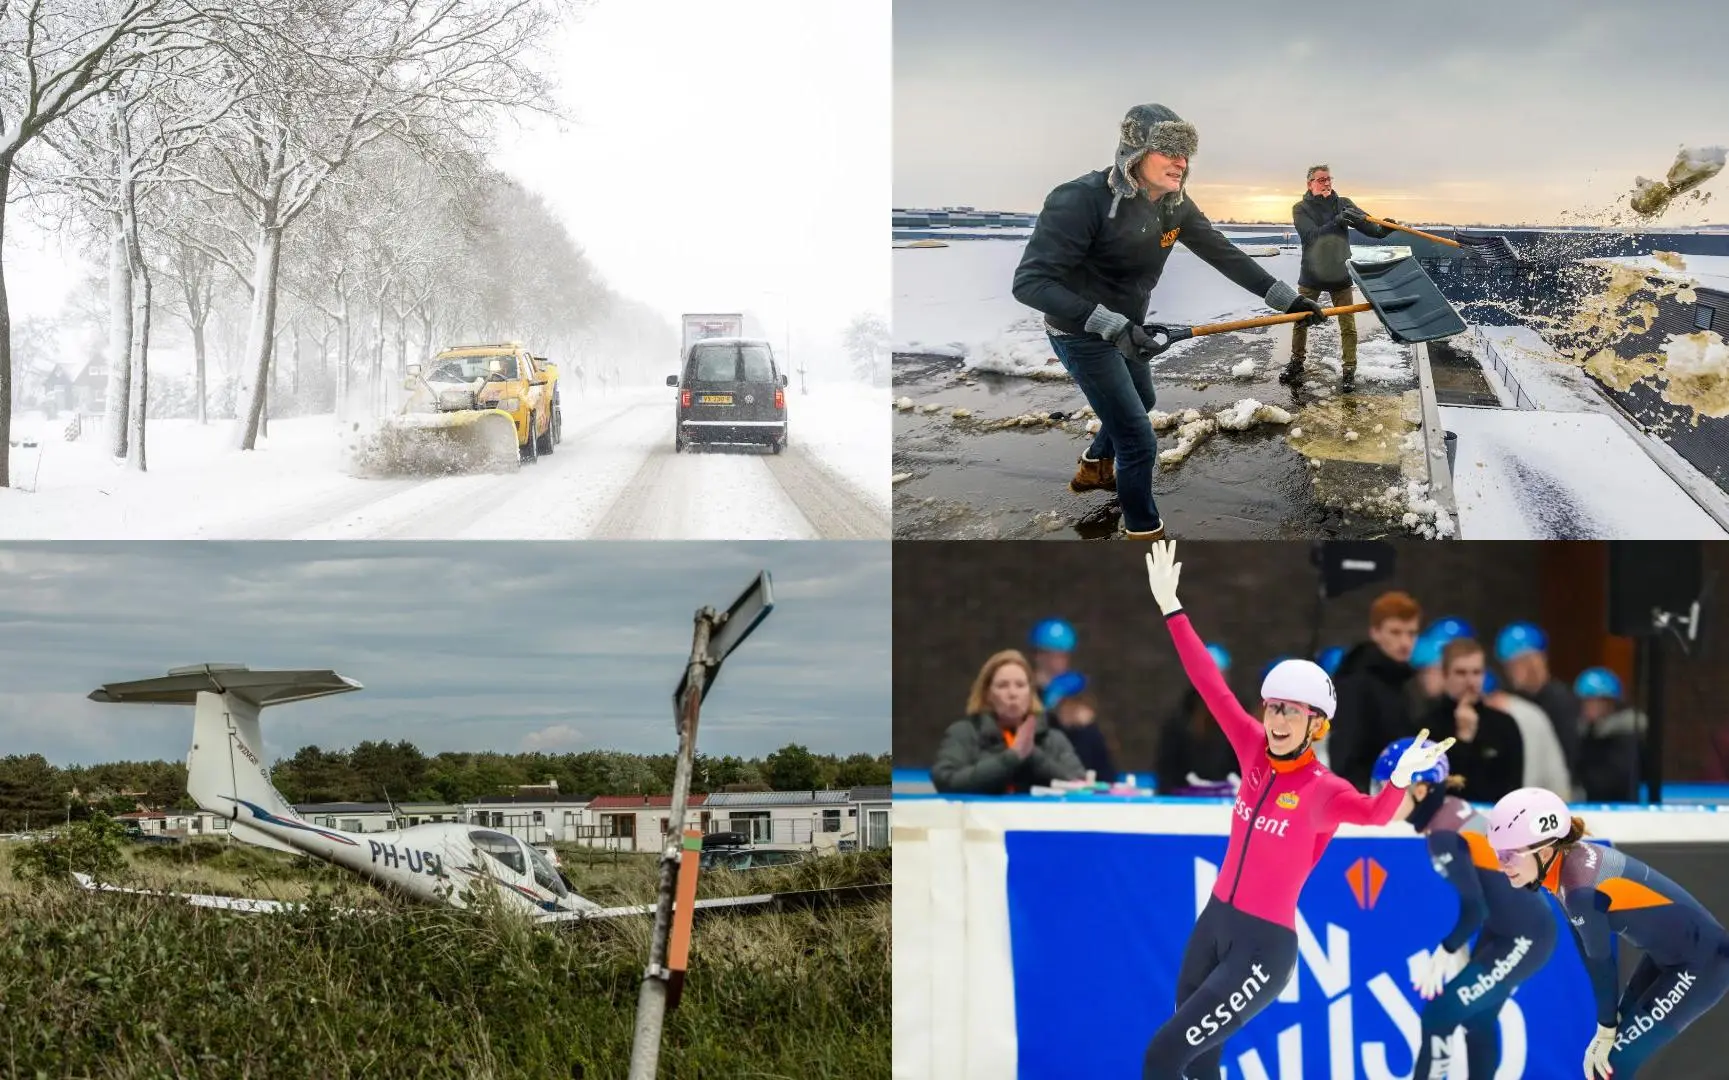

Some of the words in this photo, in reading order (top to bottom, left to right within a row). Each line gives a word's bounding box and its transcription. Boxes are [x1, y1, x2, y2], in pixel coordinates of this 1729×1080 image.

[236, 741, 259, 767] WINGS
[1232, 796, 1290, 837] essent
[1539, 814, 1559, 833] 28
[368, 840, 449, 879] PH-USL
[1456, 935, 1533, 1006] Rabobank
[1184, 961, 1272, 1048] essent
[1612, 967, 1697, 1052] Rabobank
